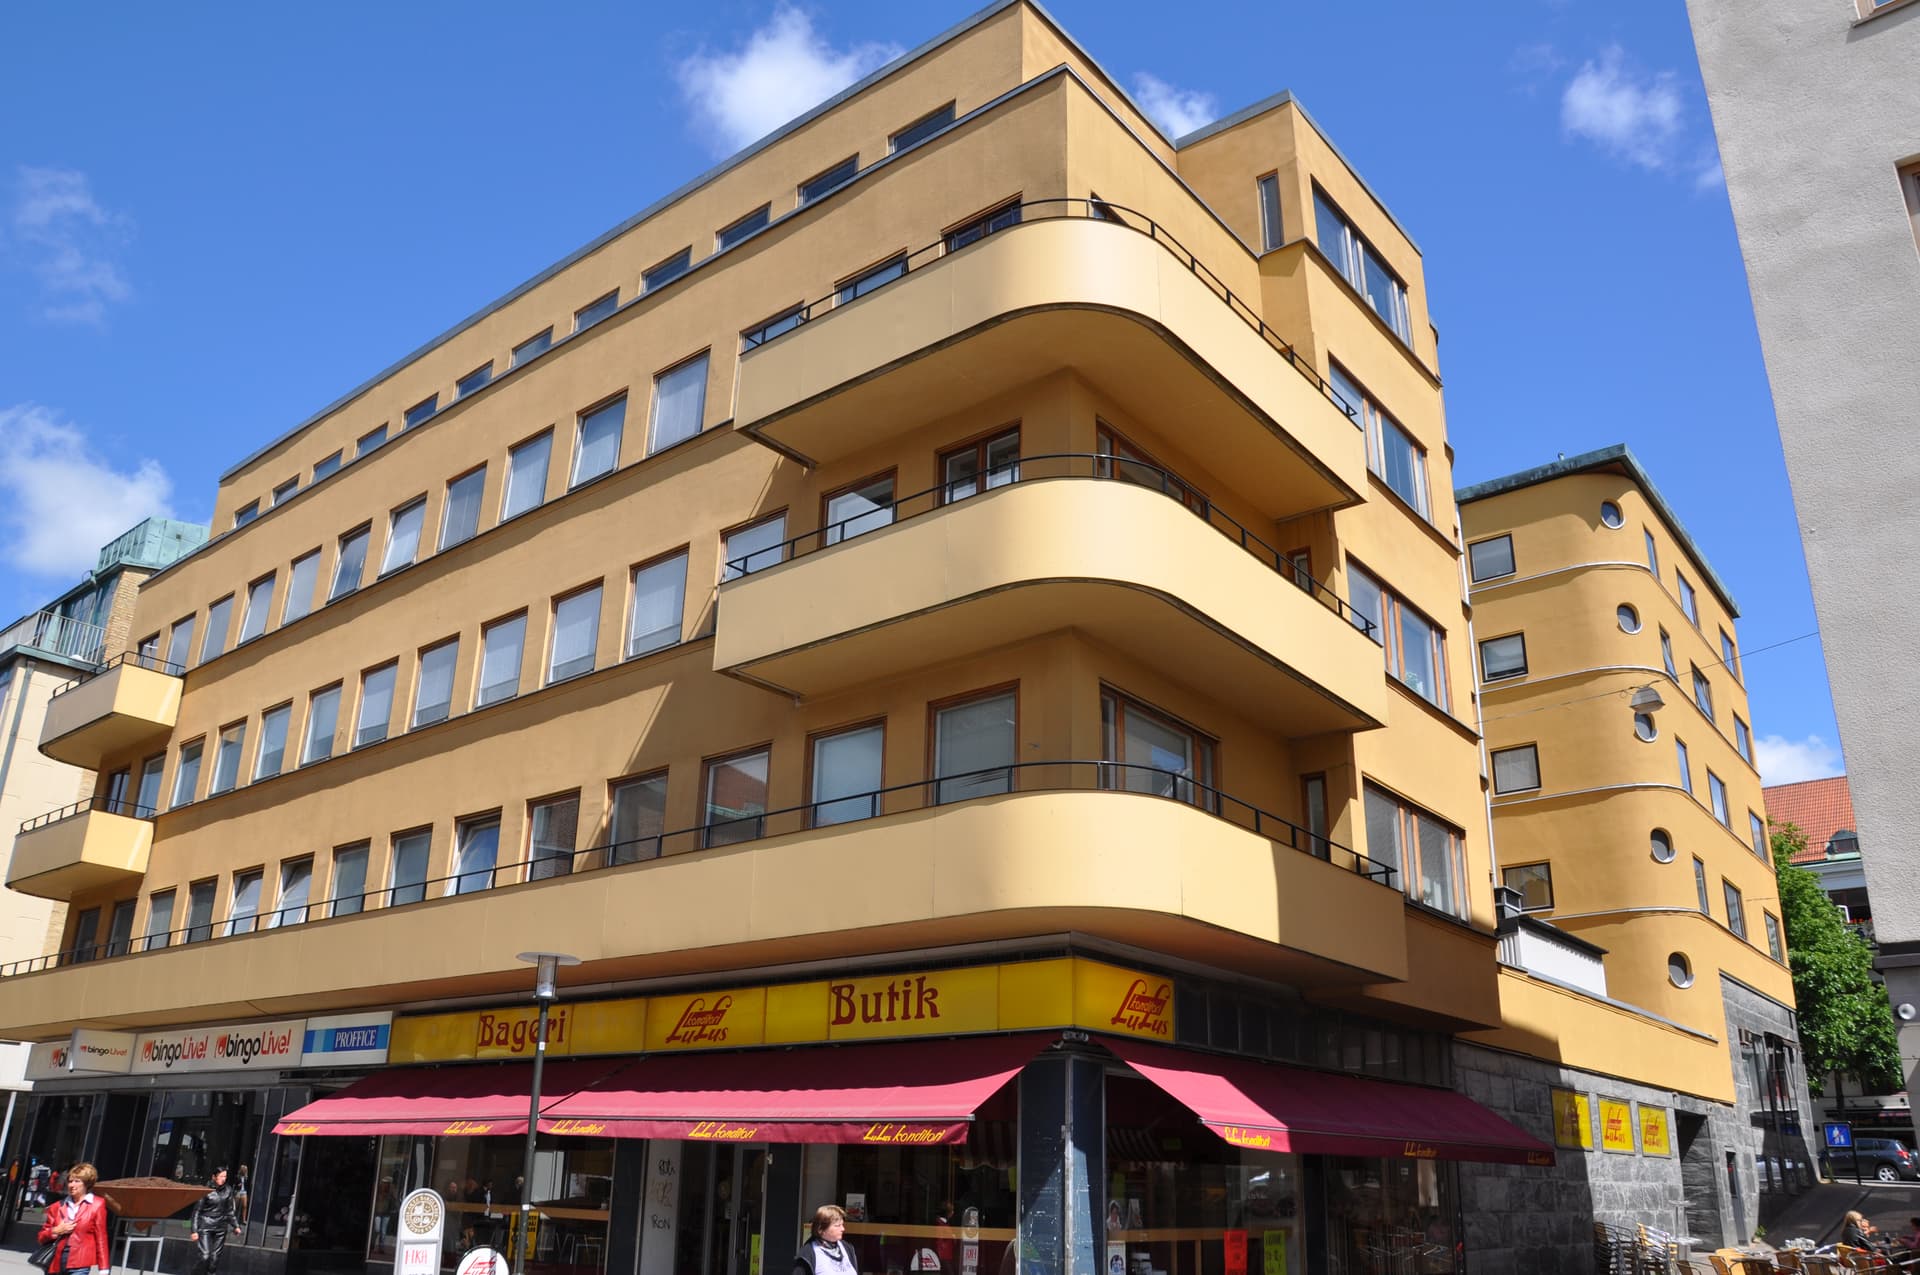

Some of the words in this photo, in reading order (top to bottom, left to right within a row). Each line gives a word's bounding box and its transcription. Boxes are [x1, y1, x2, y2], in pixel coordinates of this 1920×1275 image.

[831, 976, 940, 1025] Butik
[335, 1029, 377, 1048] PROFFICE
[478, 1010, 566, 1052] Bageri
